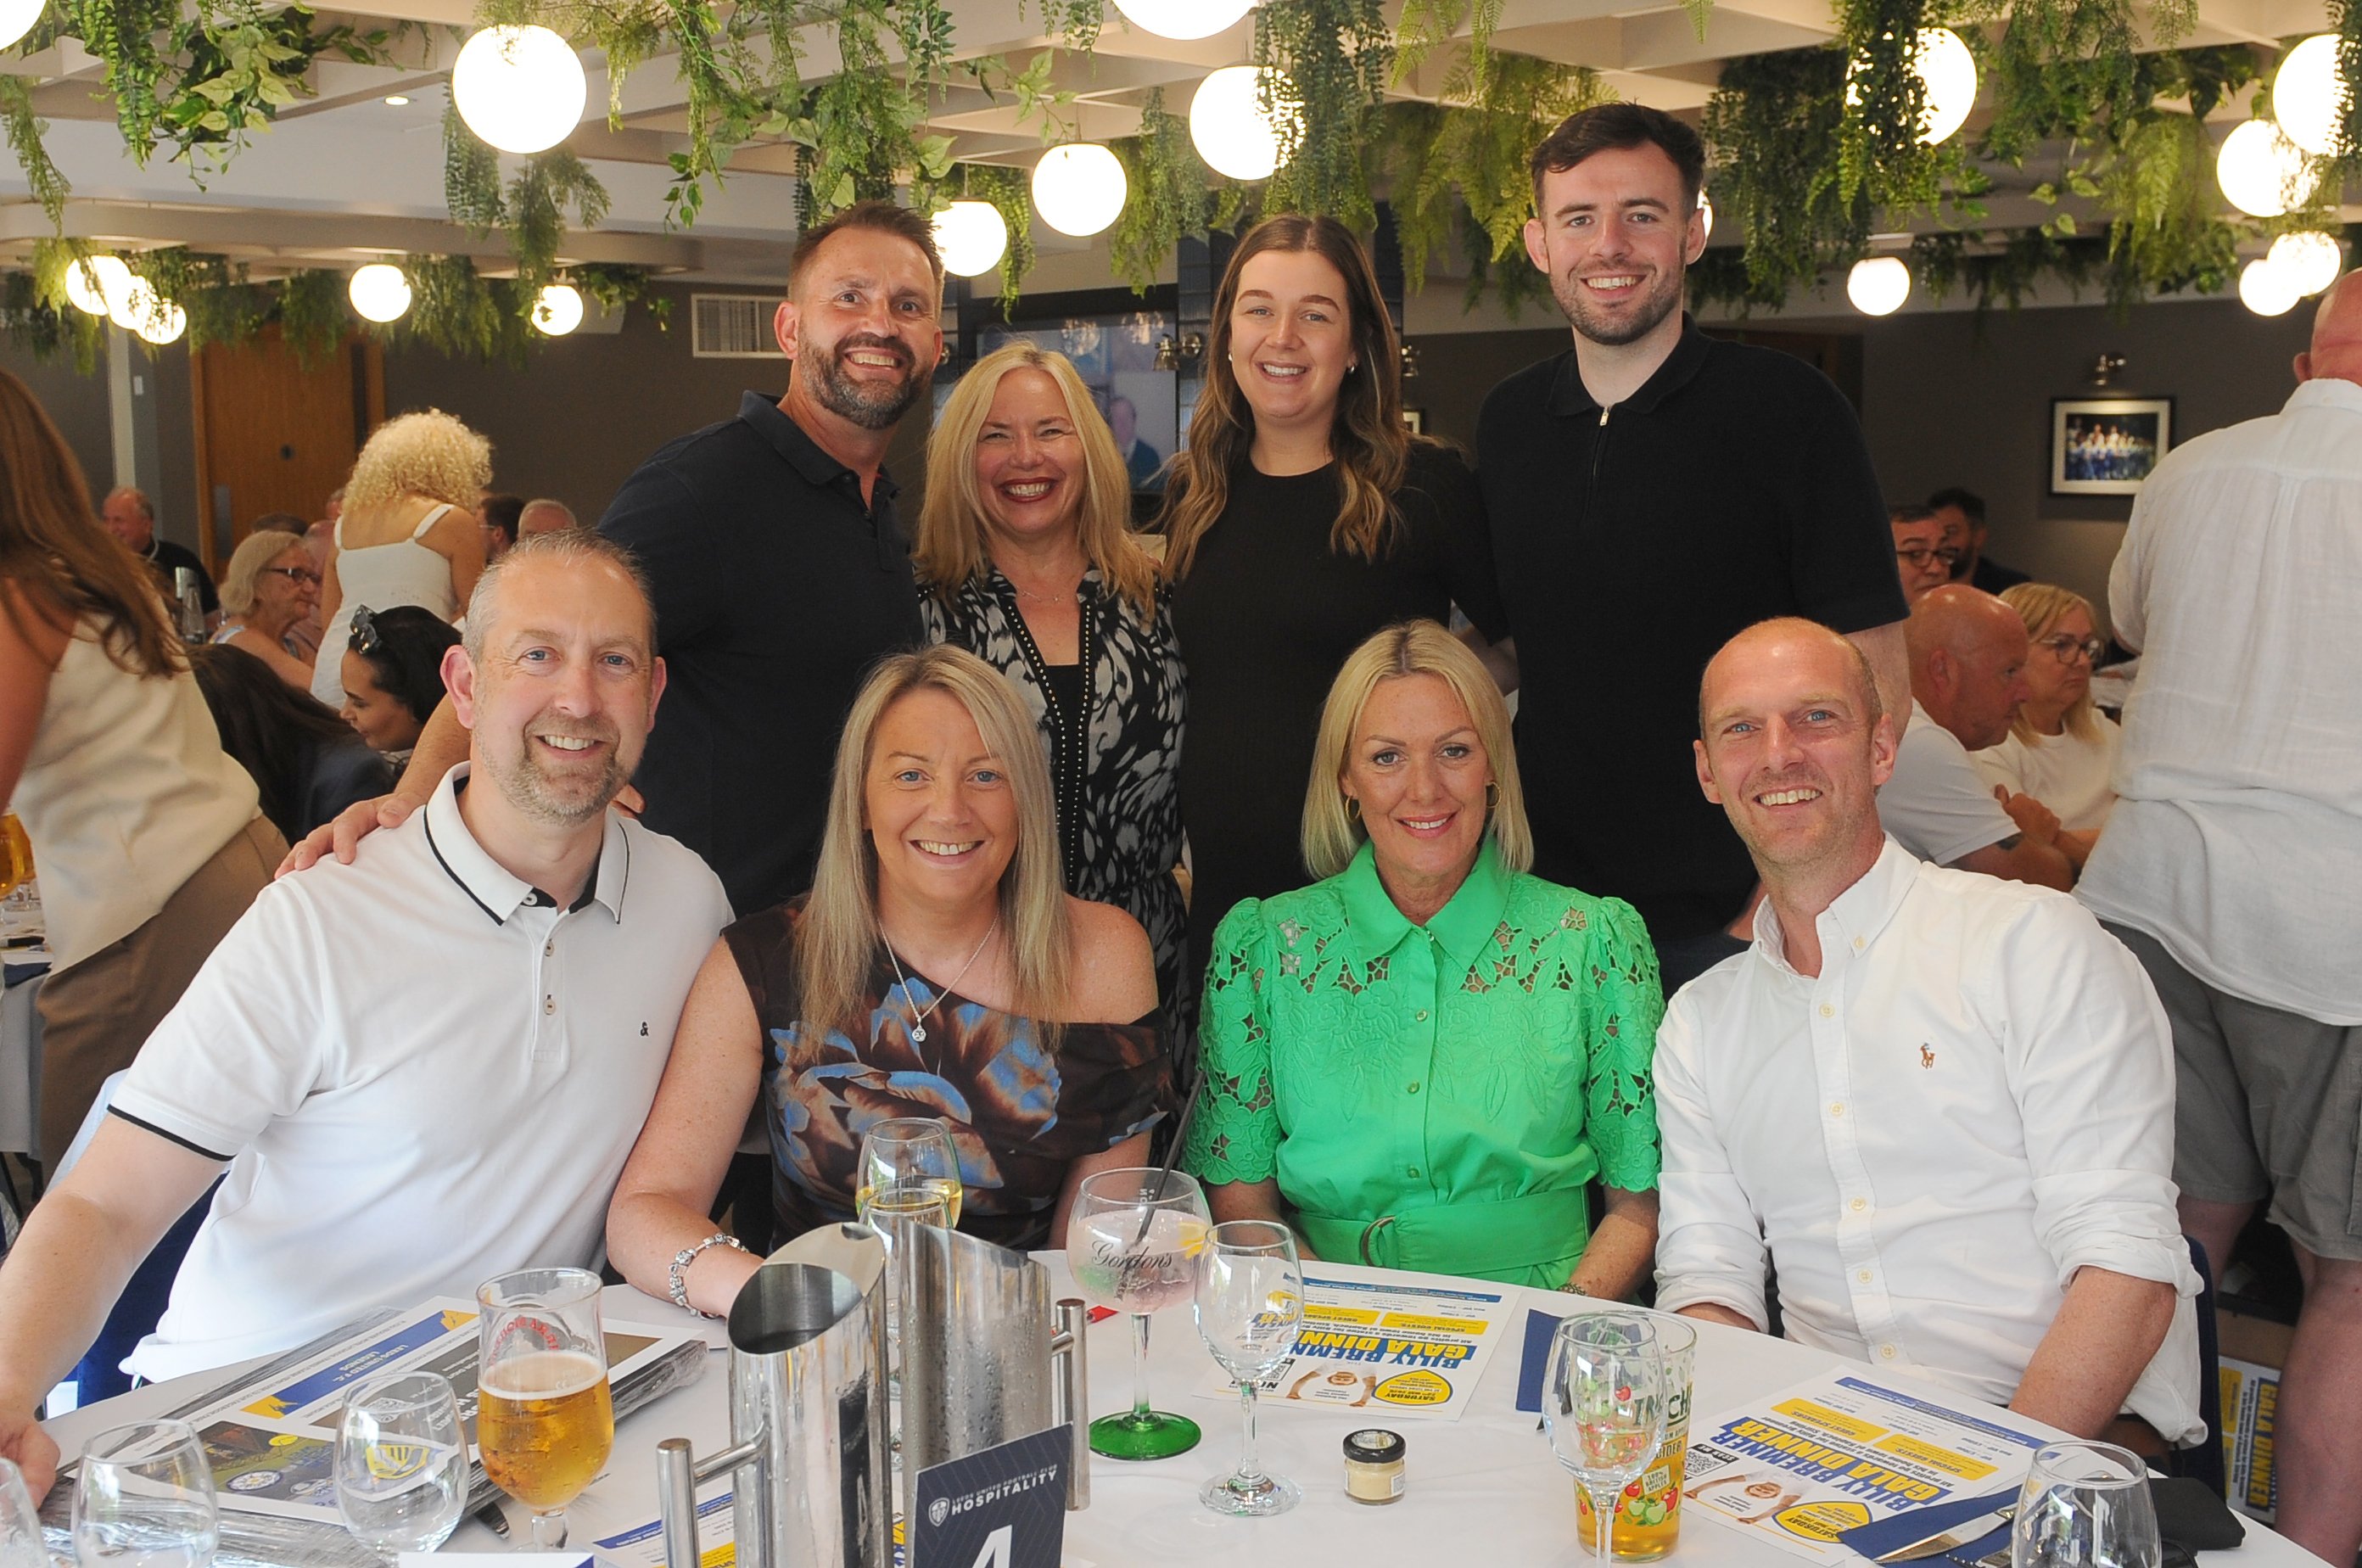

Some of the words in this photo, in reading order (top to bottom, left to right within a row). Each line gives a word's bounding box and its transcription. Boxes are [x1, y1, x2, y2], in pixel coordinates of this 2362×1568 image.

[641, 1022, 648, 1036] &
[1091, 1240, 1173, 1269] Gordon's
[1295, 1330, 1381, 1352] DINN
[1384, 1338, 1469, 1358] GALA
[376, 1343, 411, 1358] LEEDS
[1286, 1342, 1385, 1363] BREMN
[334, 1350, 383, 1372] LEGENDS
[345, 1357, 387, 1375] UNITED
[1386, 1352, 1462, 1369] BILLY
[1384, 1392, 1436, 1401] SATURDAY
[2254, 1382, 2278, 1433] GALA
[1759, 1415, 1798, 1431] Bremner
[1787, 1420, 1822, 1434] Stirling
[1829, 1425, 1857, 1436] GUEST
[1795, 1428, 1817, 1438] Billy
[1727, 1417, 1858, 1471] DINNER
[1827, 1440, 1856, 1453] statue
[1864, 1448, 1889, 1458] town
[1706, 1429, 1842, 1485] BREMNER
[1861, 1453, 1899, 1468] towards
[1886, 1455, 1913, 1467] home
[1926, 1459, 1963, 1473] SPECIAL
[1908, 1469, 1942, 1483] profits
[1911, 1464, 1928, 1472] his
[2249, 1434, 2272, 1507] DINNER
[952, 1492, 975, 1504] LEEDS
[976, 1483, 1002, 1496] UNITED
[1003, 1470, 1038, 1486] FOOTBALL
[1039, 1464, 1058, 1474] CLUB
[1842, 1459, 1945, 1503] GALA
[951, 1470, 1056, 1515] HOSPITALITY
[1829, 1476, 1917, 1512] BILLY
[1783, 1515, 1838, 1539] SATURDAY
[971, 1524, 1013, 1568] 4
